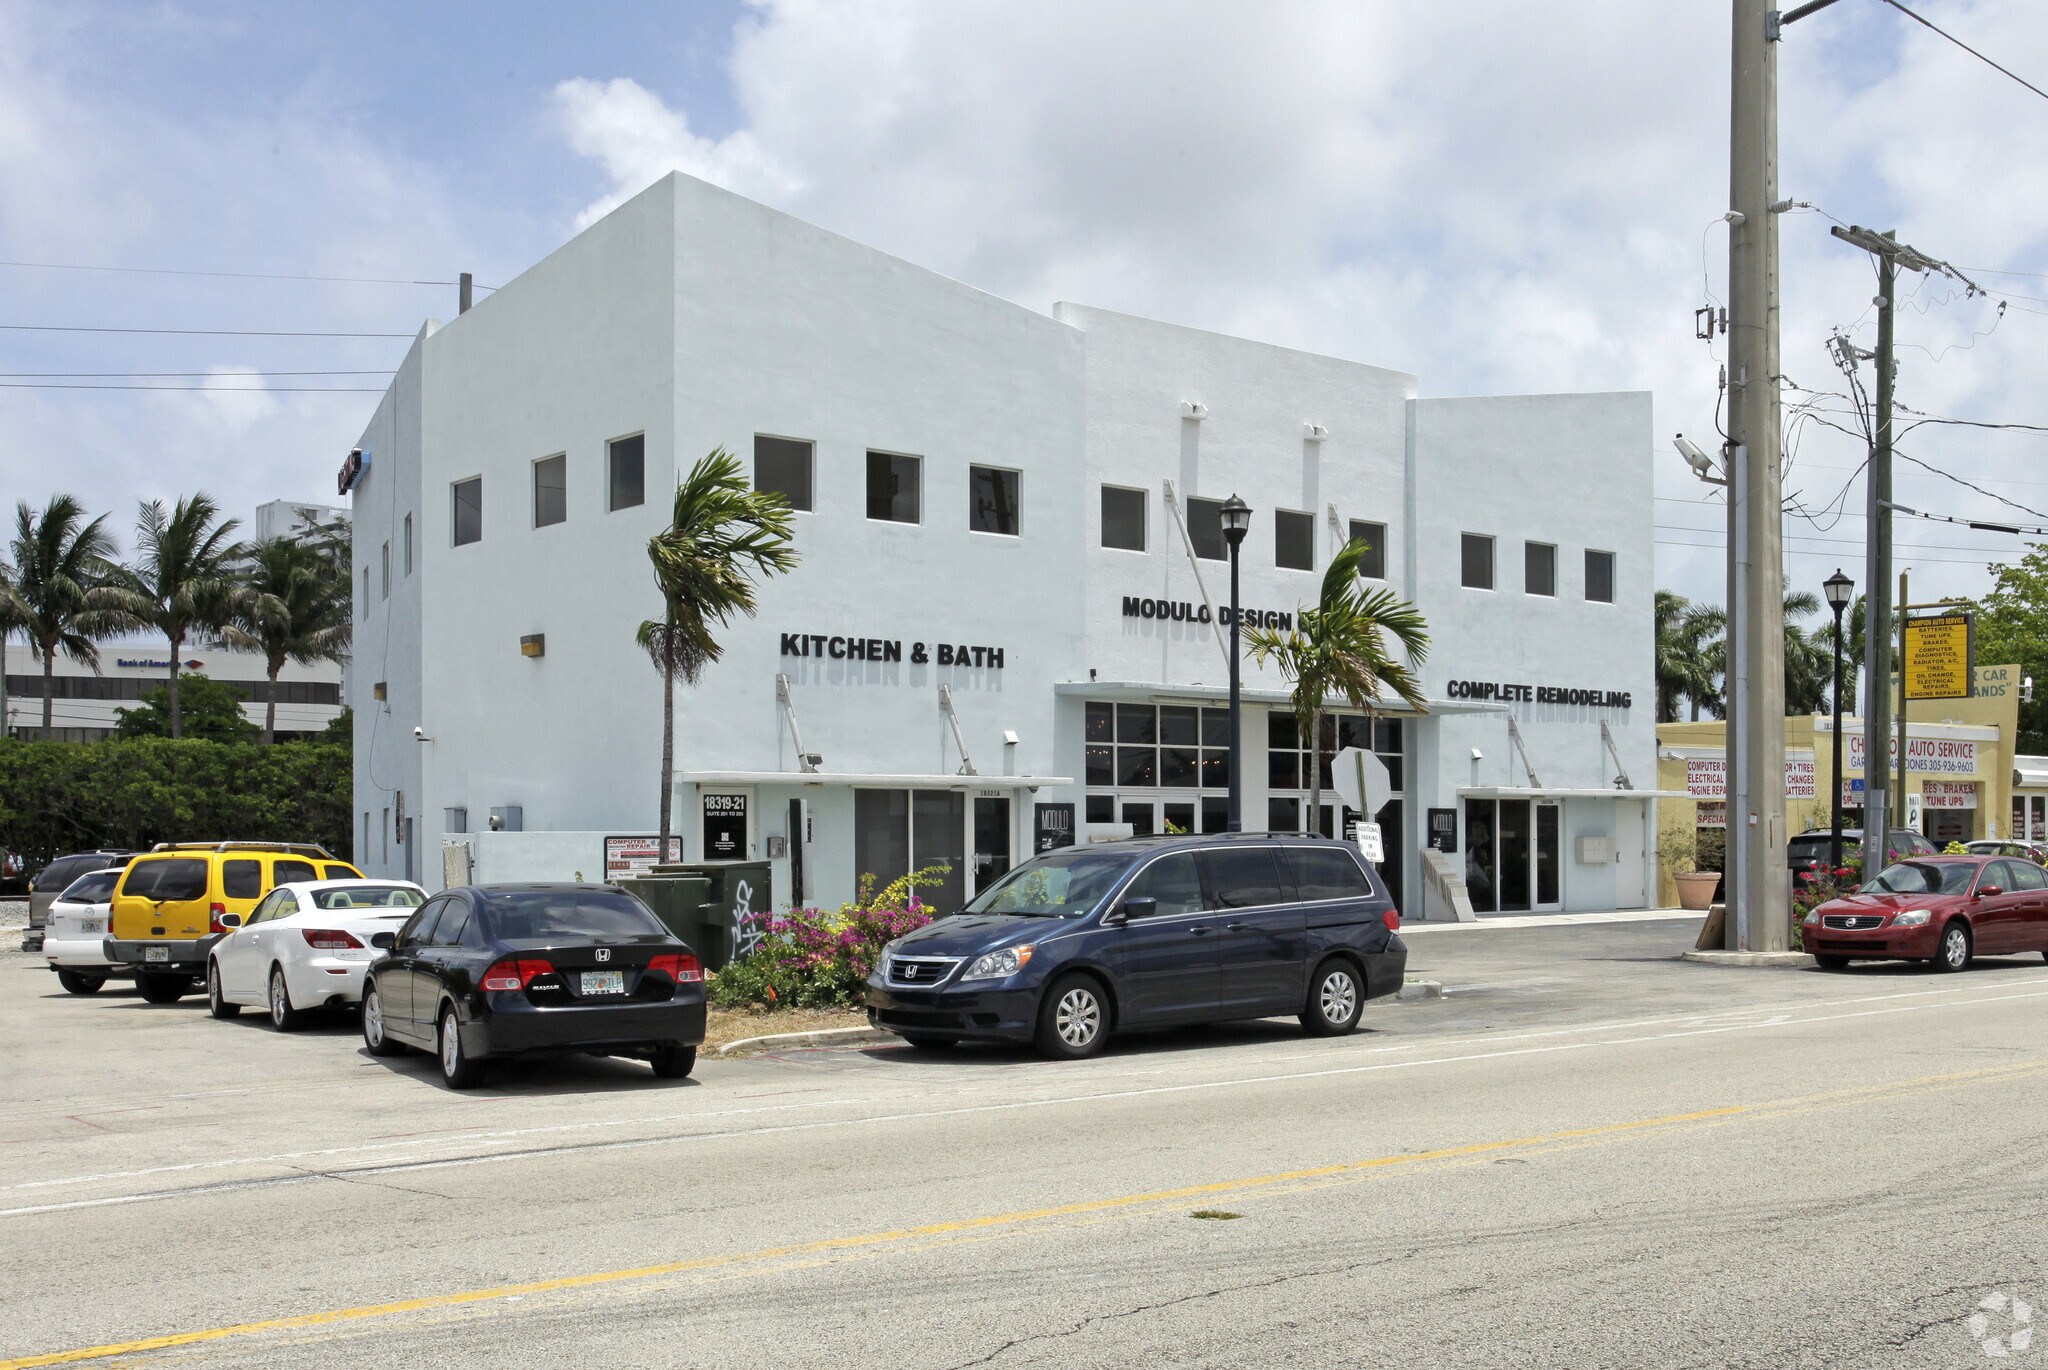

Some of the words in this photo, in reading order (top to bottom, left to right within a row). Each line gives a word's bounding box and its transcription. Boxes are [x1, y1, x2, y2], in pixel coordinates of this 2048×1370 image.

[1122, 596, 1211, 624] MODULO
[1218, 606, 1292, 631] DESIGN
[781, 633, 902, 662] KITCHEN
[911, 642, 929, 664] &
[938, 644, 1005, 669] BATH
[117, 659, 138, 668] Bank
[148, 660, 181, 668] Amera
[1983, 669, 2008, 681] CAR
[1447, 680, 1533, 703] COMPLETE
[1536, 686, 1632, 709] REMODELING
[1974, 681, 2012, 698] ANDS"
[1909, 740, 1935, 757] AUTO
[1938, 742, 1973, 759] SERVICE
[1687, 761, 1720, 771] COMPUTER
[1798, 763, 1815, 773] TIRES
[1929, 760, 1974, 772] 305-936-9603
[1687, 773, 1724, 784] ELECTRICAL
[1787, 774, 1815, 784] CHANGES
[1687, 785, 1711, 795] ENGINE
[1712, 785, 1728, 796] REPA
[1785, 785, 1815, 796] BATTERIES
[1923, 783, 1938, 794] RES
[1943, 784, 1974, 794] BRAKES
[704, 796, 744, 810] 18319-21
[1926, 796, 1946, 806] TUNE
[1948, 796, 1964, 806] UPS
[1041, 810, 1068, 830] MODULO
[1433, 814, 1452, 831] MODULO
[583, 978, 597, 990] 992
